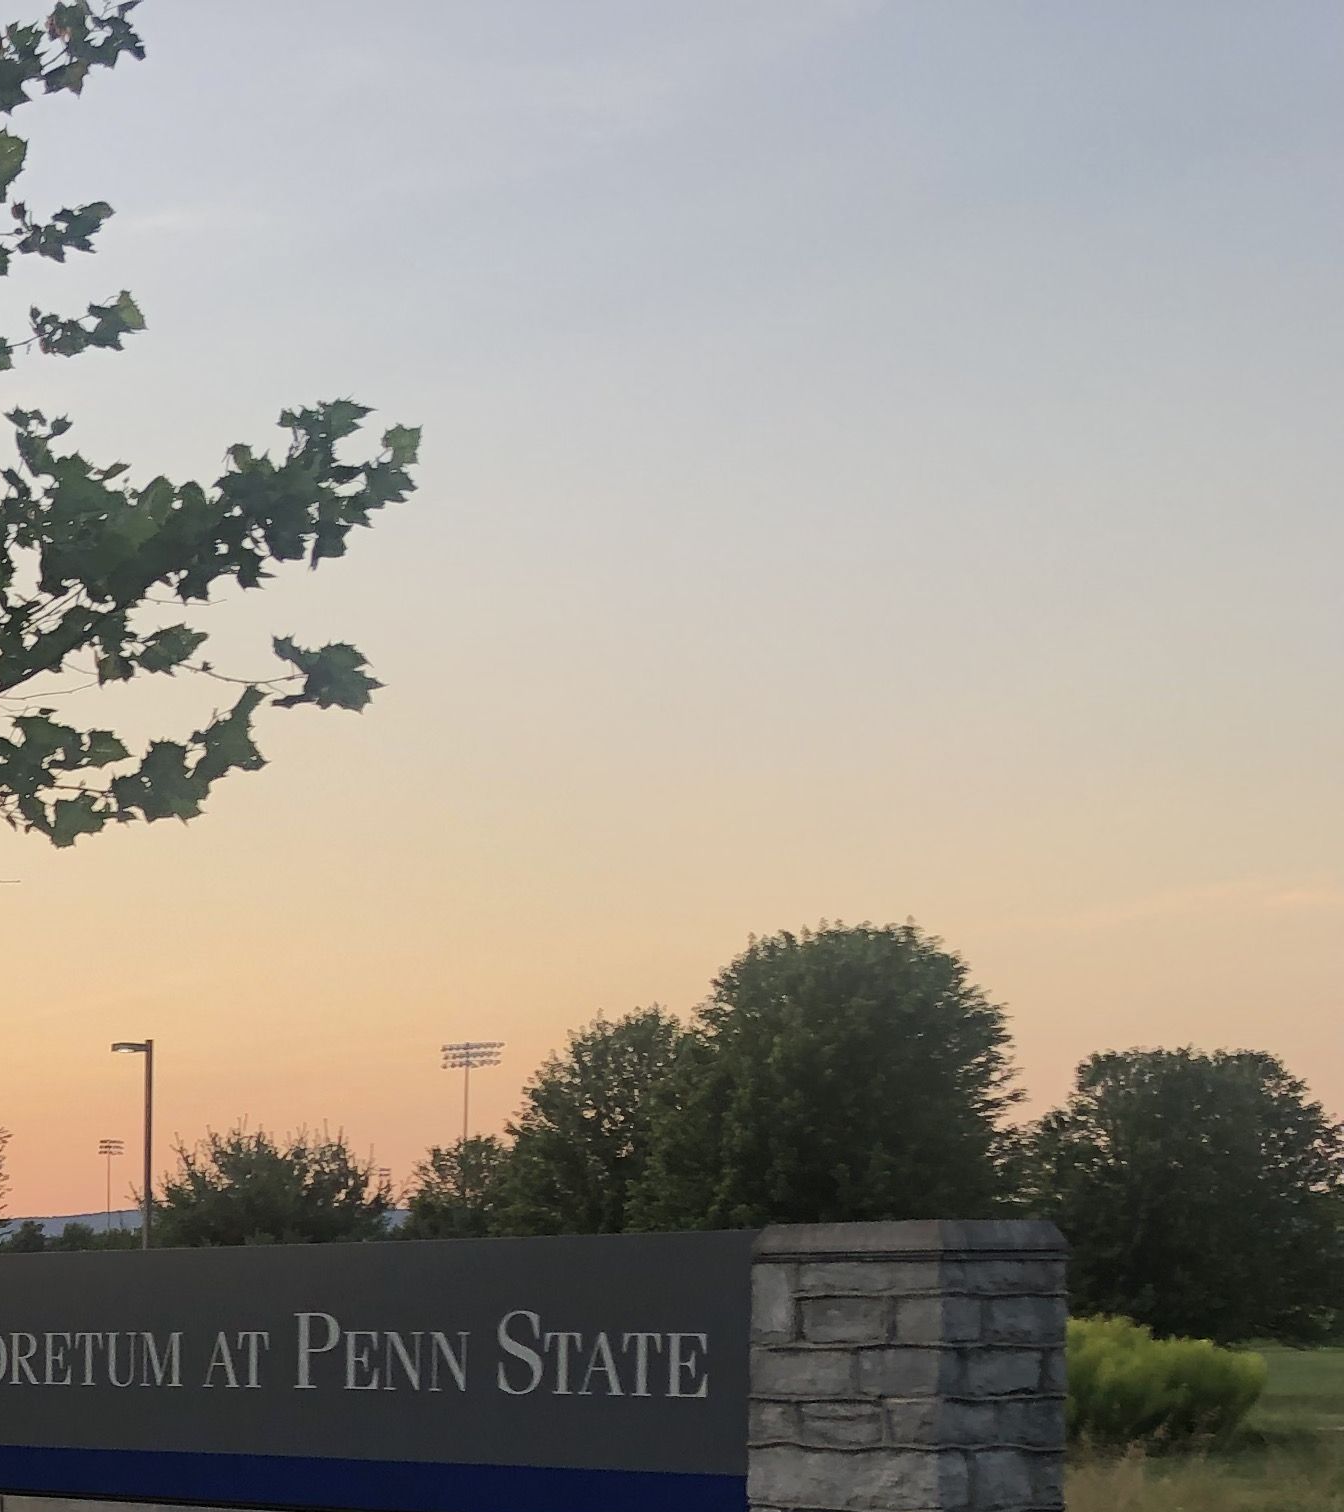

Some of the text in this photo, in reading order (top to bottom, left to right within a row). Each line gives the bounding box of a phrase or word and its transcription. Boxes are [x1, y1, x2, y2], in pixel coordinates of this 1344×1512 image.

[202, 1331, 270, 1389] AT
[293, 1312, 471, 1392] PENN
[497, 1310, 709, 1398] STATE
